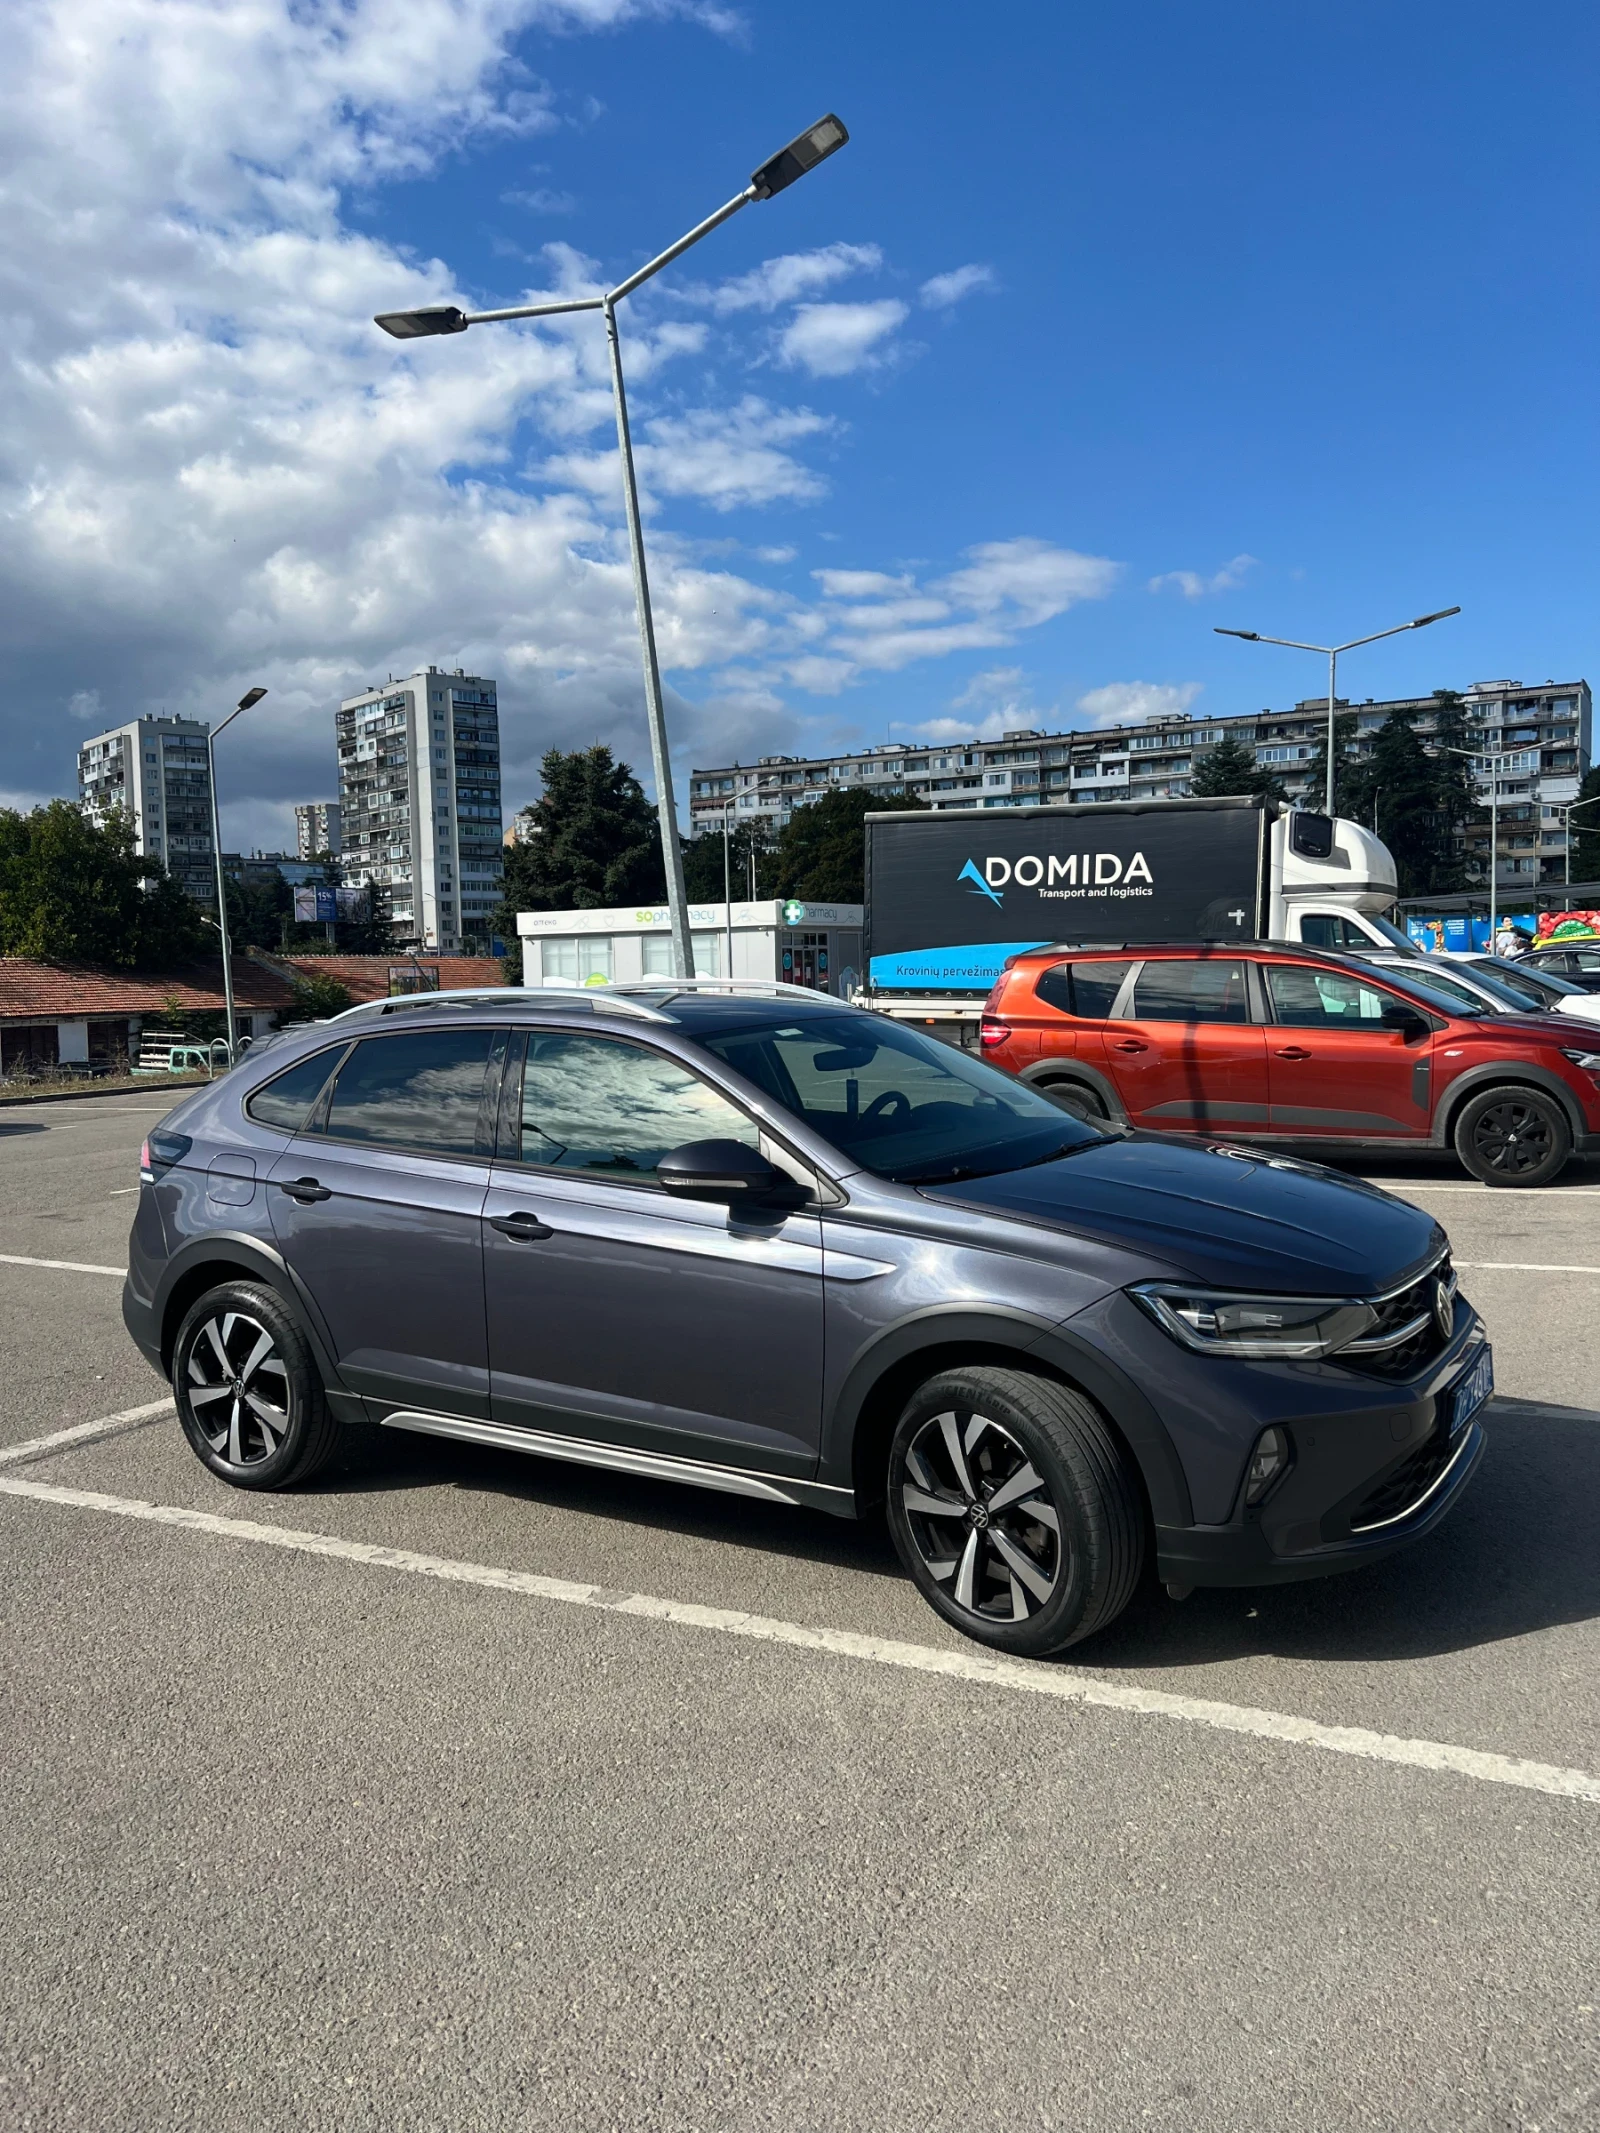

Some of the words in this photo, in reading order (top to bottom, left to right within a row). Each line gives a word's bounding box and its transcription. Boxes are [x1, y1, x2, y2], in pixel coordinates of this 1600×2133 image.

[1037, 888, 1086, 900] Transport
[1087, 886, 1107, 897] and
[1109, 886, 1153, 899] logistics
[896, 965, 940, 979] Krovinių
[943, 965, 1006, 979] pervežimas
